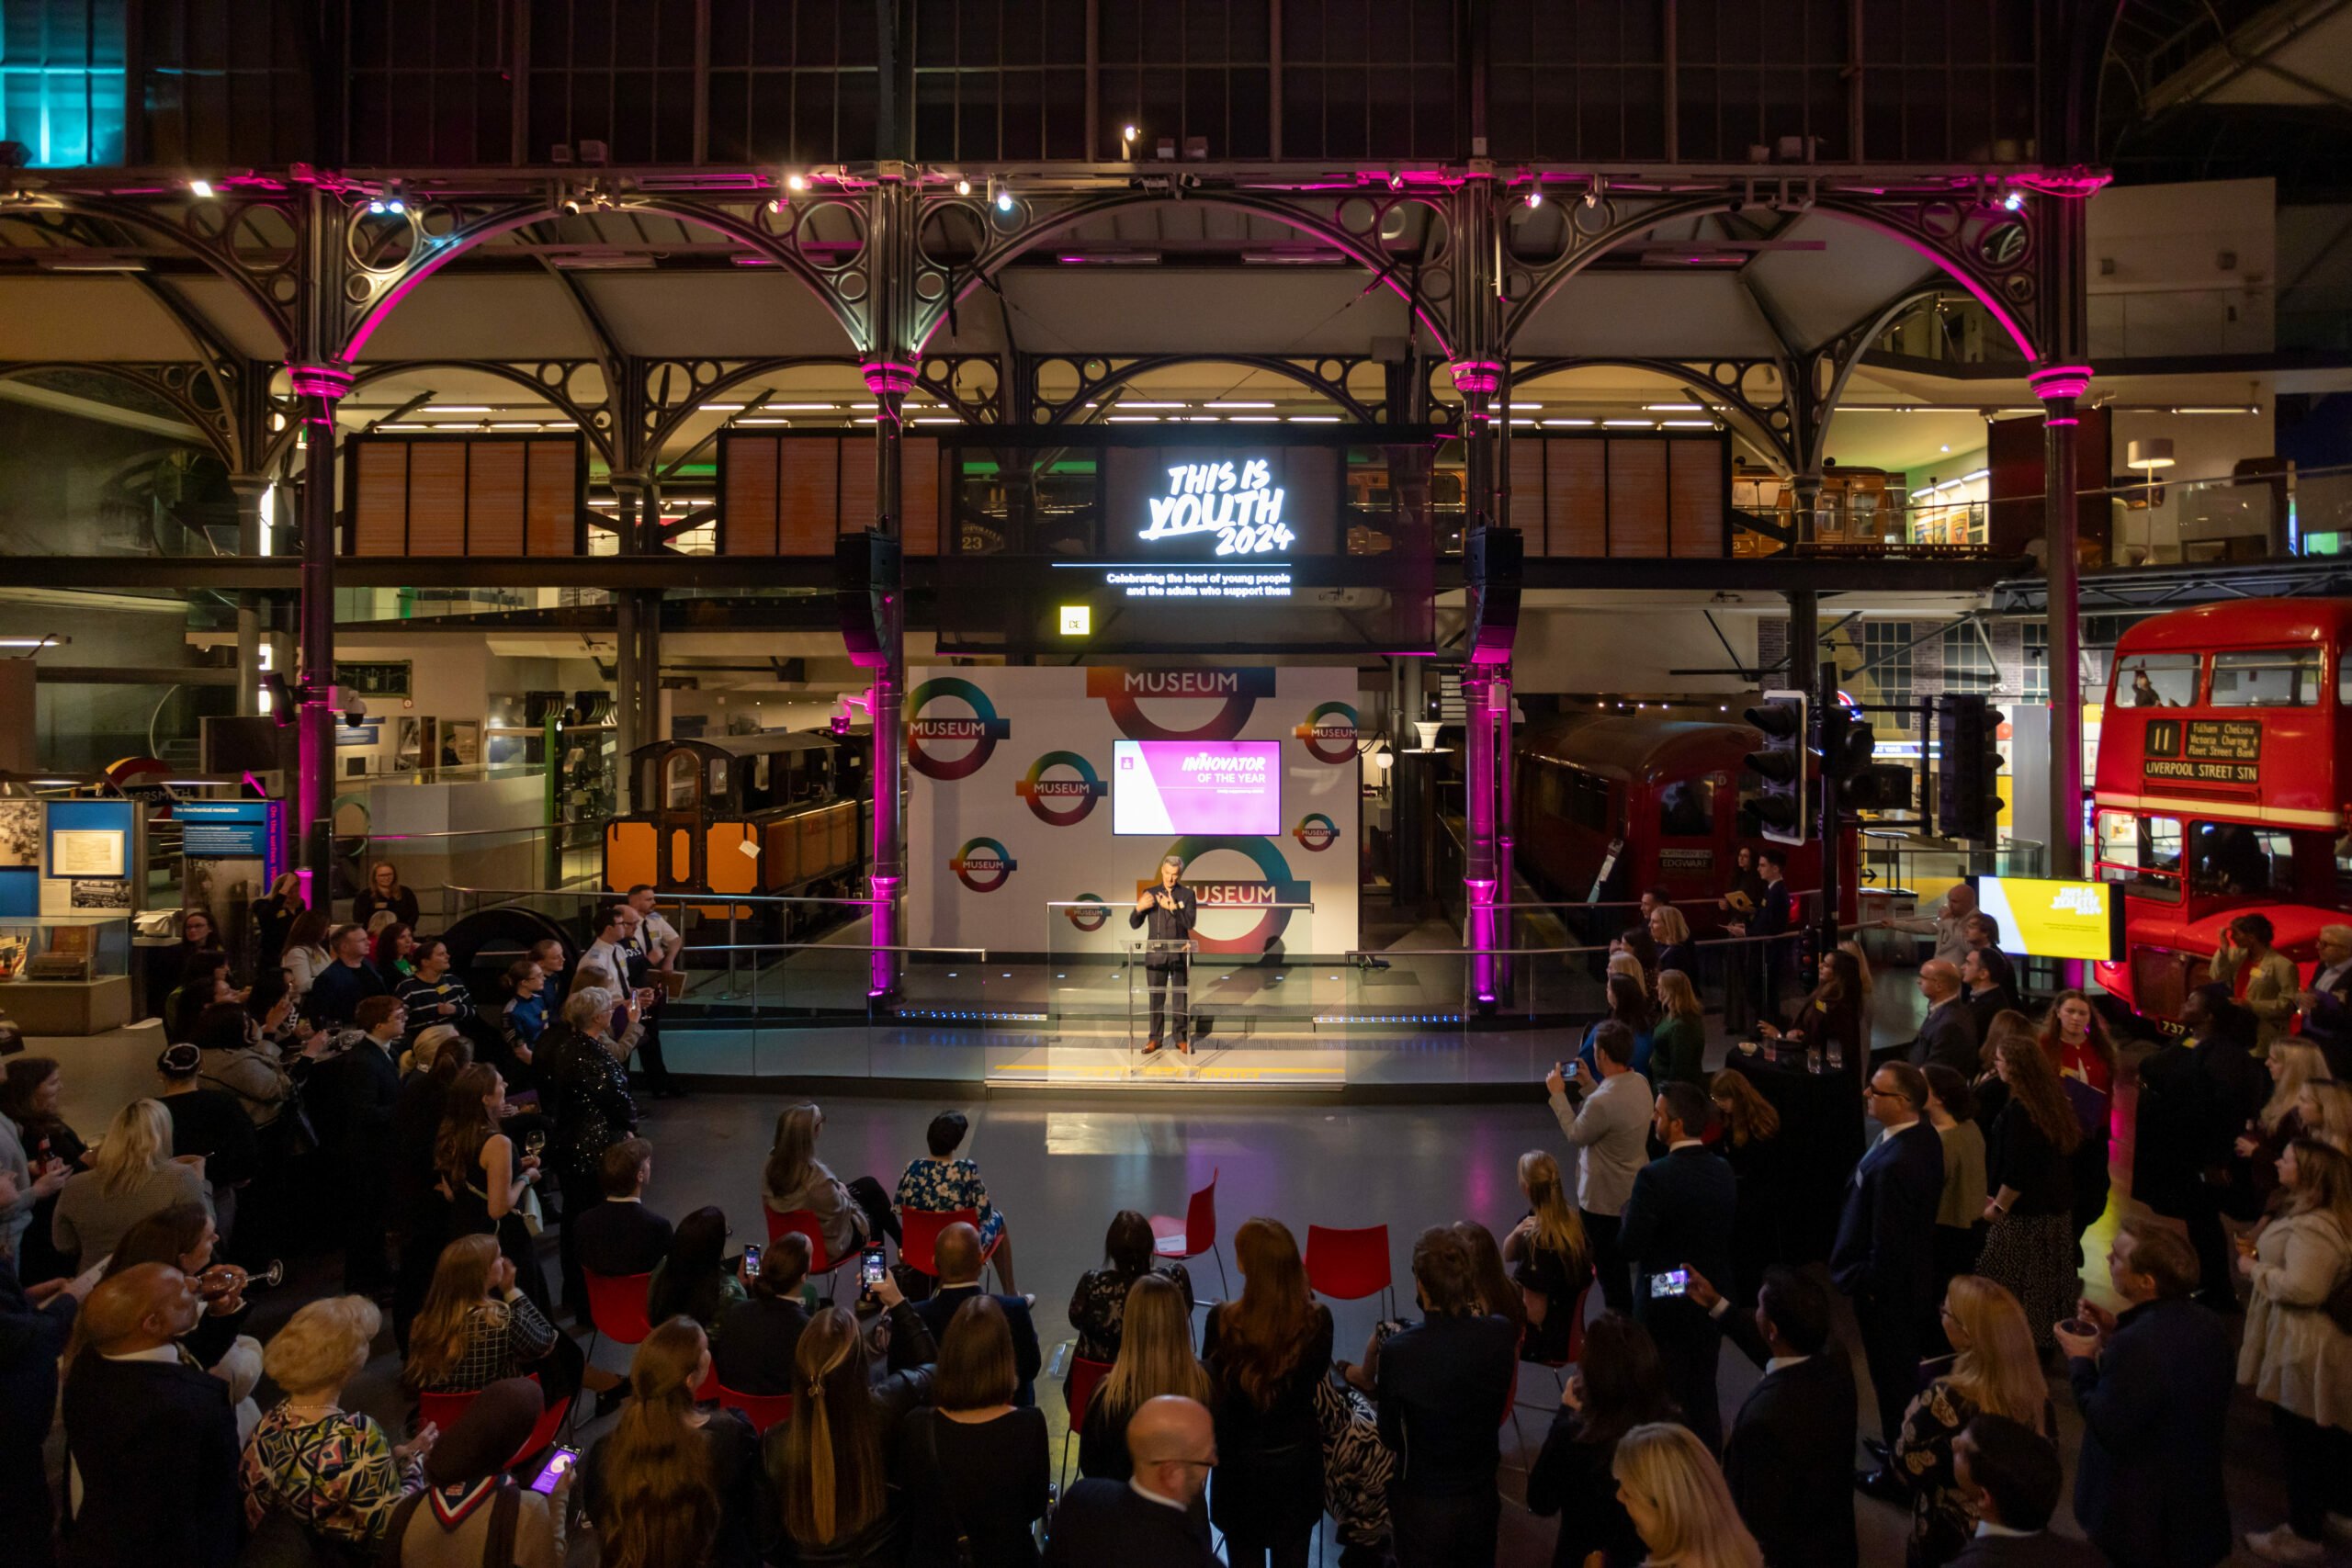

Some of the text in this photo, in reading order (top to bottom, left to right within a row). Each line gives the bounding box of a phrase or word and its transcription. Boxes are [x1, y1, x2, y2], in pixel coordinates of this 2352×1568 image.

[1168, 459, 1271, 495] THIS IS
[1139, 488, 1284, 540] YOUTH
[962, 536, 982, 549] 23
[1216, 523, 1295, 556] 2024
[1106, 573, 1291, 586] Celebrating the best of young people
[1126, 586, 1291, 597] and the adults who support them
[1125, 672, 1238, 692] MUSEUM
[555, 720, 563, 732] 6
[910, 722, 985, 736] MUSEUM
[2193, 723, 2255, 734] Fulham Chelsea
[1311, 728, 1358, 738] MUSEUM
[2154, 728, 2169, 750] 11
[2190, 735, 2217, 745] Victoria
[2222, 736, 2248, 749] Charing
[2188, 745, 2255, 758] Fleet Street Bank
[1182, 752, 1266, 772] INNOVATOR
[2146, 761, 2256, 781] LIVERPOOL STREET STN
[1197, 773, 1266, 784] OF THE YEAR
[1034, 784, 1090, 794] MUSEUM
[963, 861, 1004, 869] MUSEUM
[1662, 859, 1707, 868] EDGWARE
[1193, 886, 1276, 903] USEUM
[2162, 1021, 2185, 1035] 737
